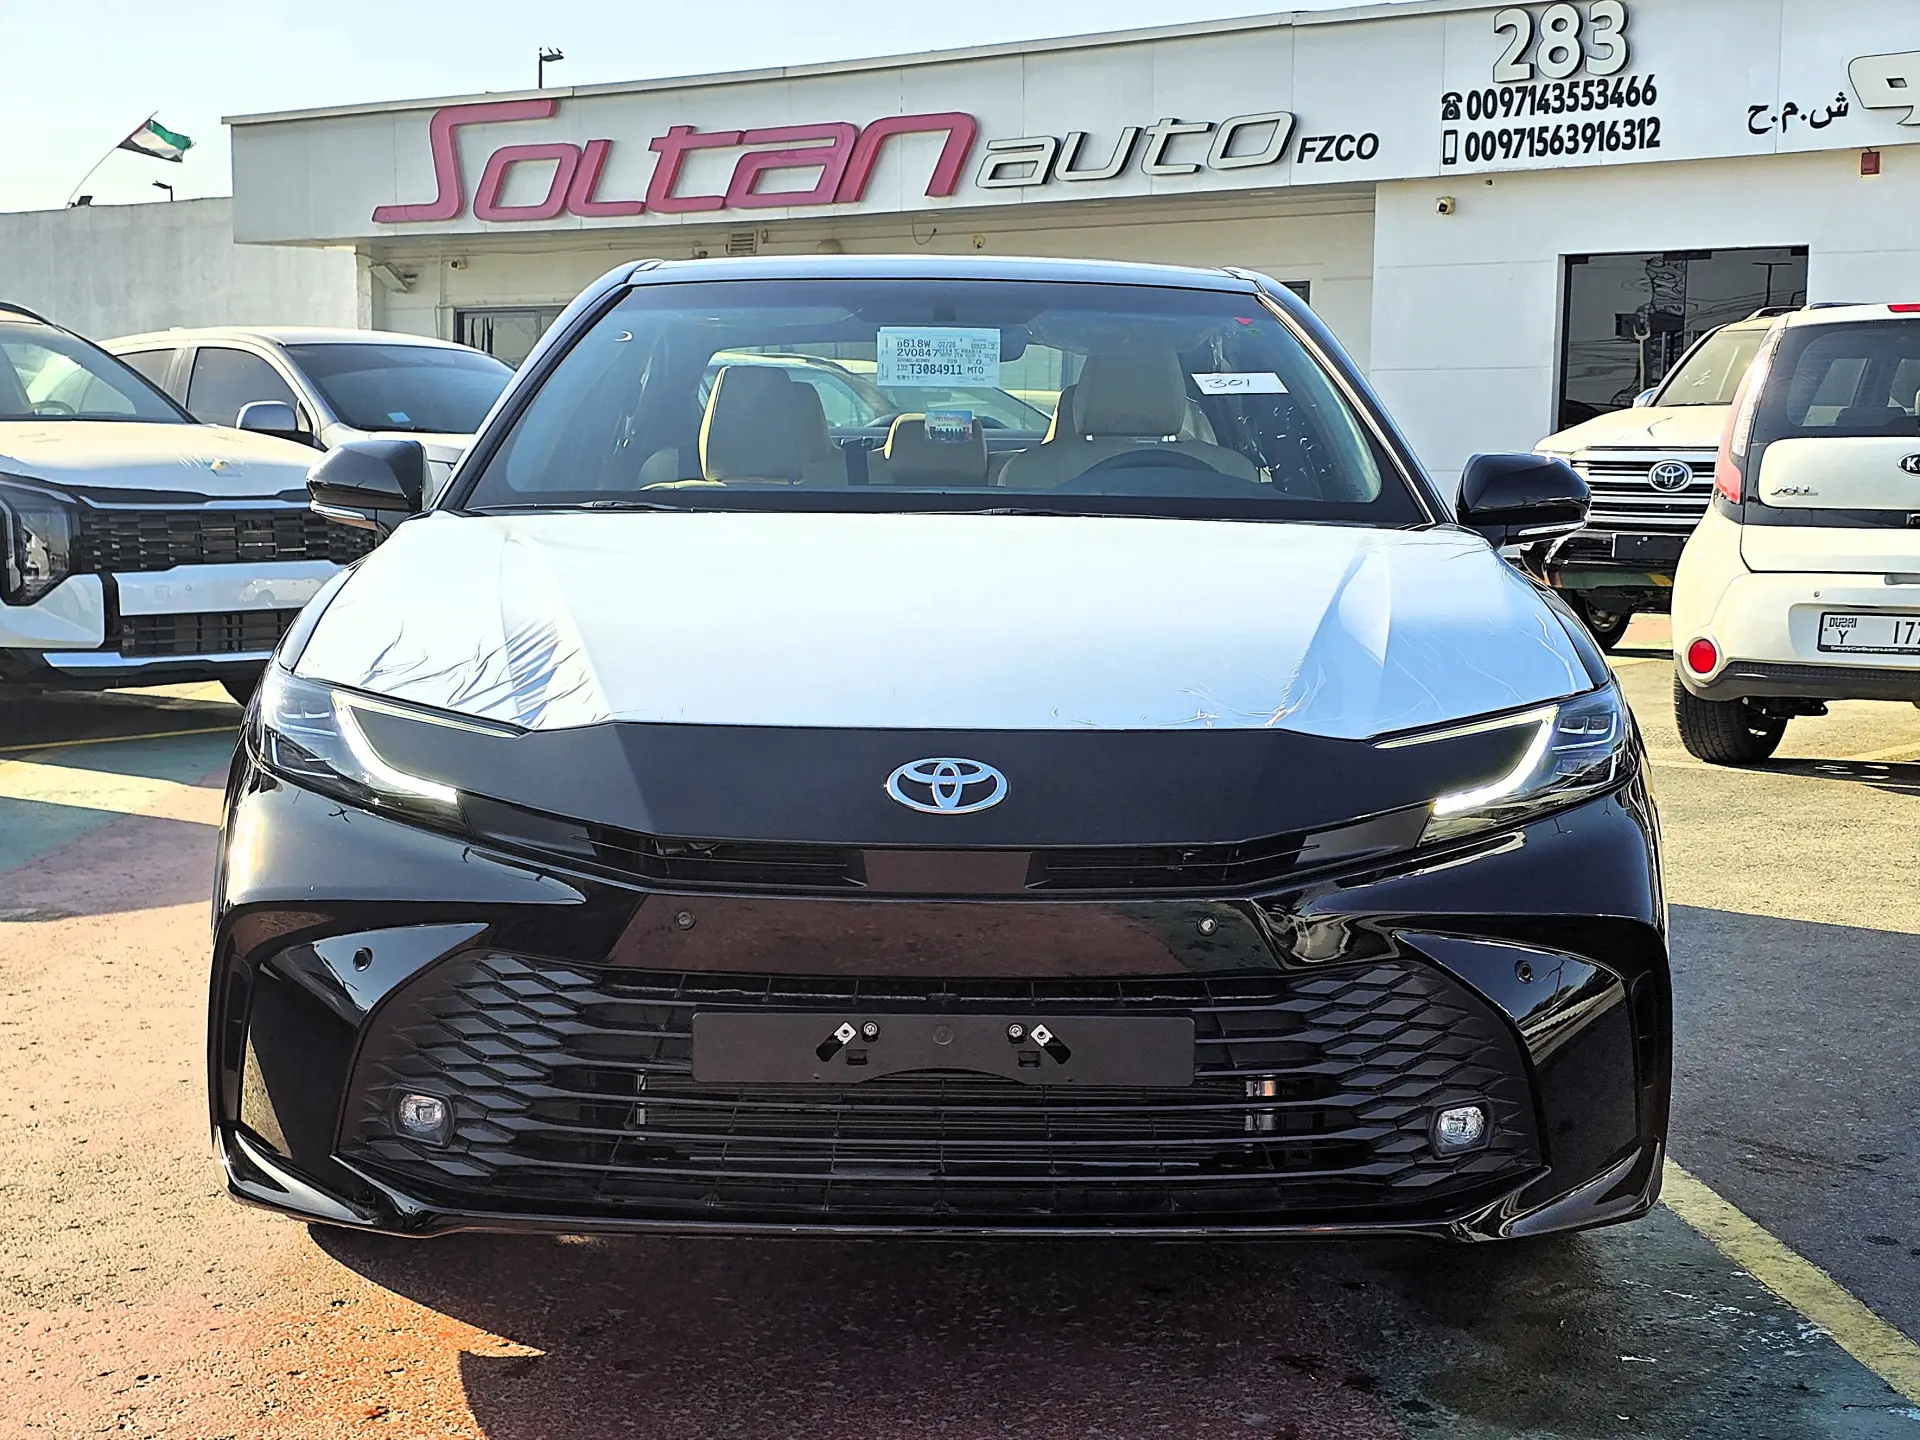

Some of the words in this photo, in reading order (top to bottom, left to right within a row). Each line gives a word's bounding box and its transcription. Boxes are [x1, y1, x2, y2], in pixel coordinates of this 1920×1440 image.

[1493, 0, 1629, 83] 283
[1467, 74, 1657, 120] 0097143553466
[975, 111, 1297, 188] auto
[1297, 133, 1379, 163] FZCO
[1465, 117, 1661, 162] 00971563916312
[910, 364, 962, 375] T3084911
[1838, 630, 1849, 645] Y
